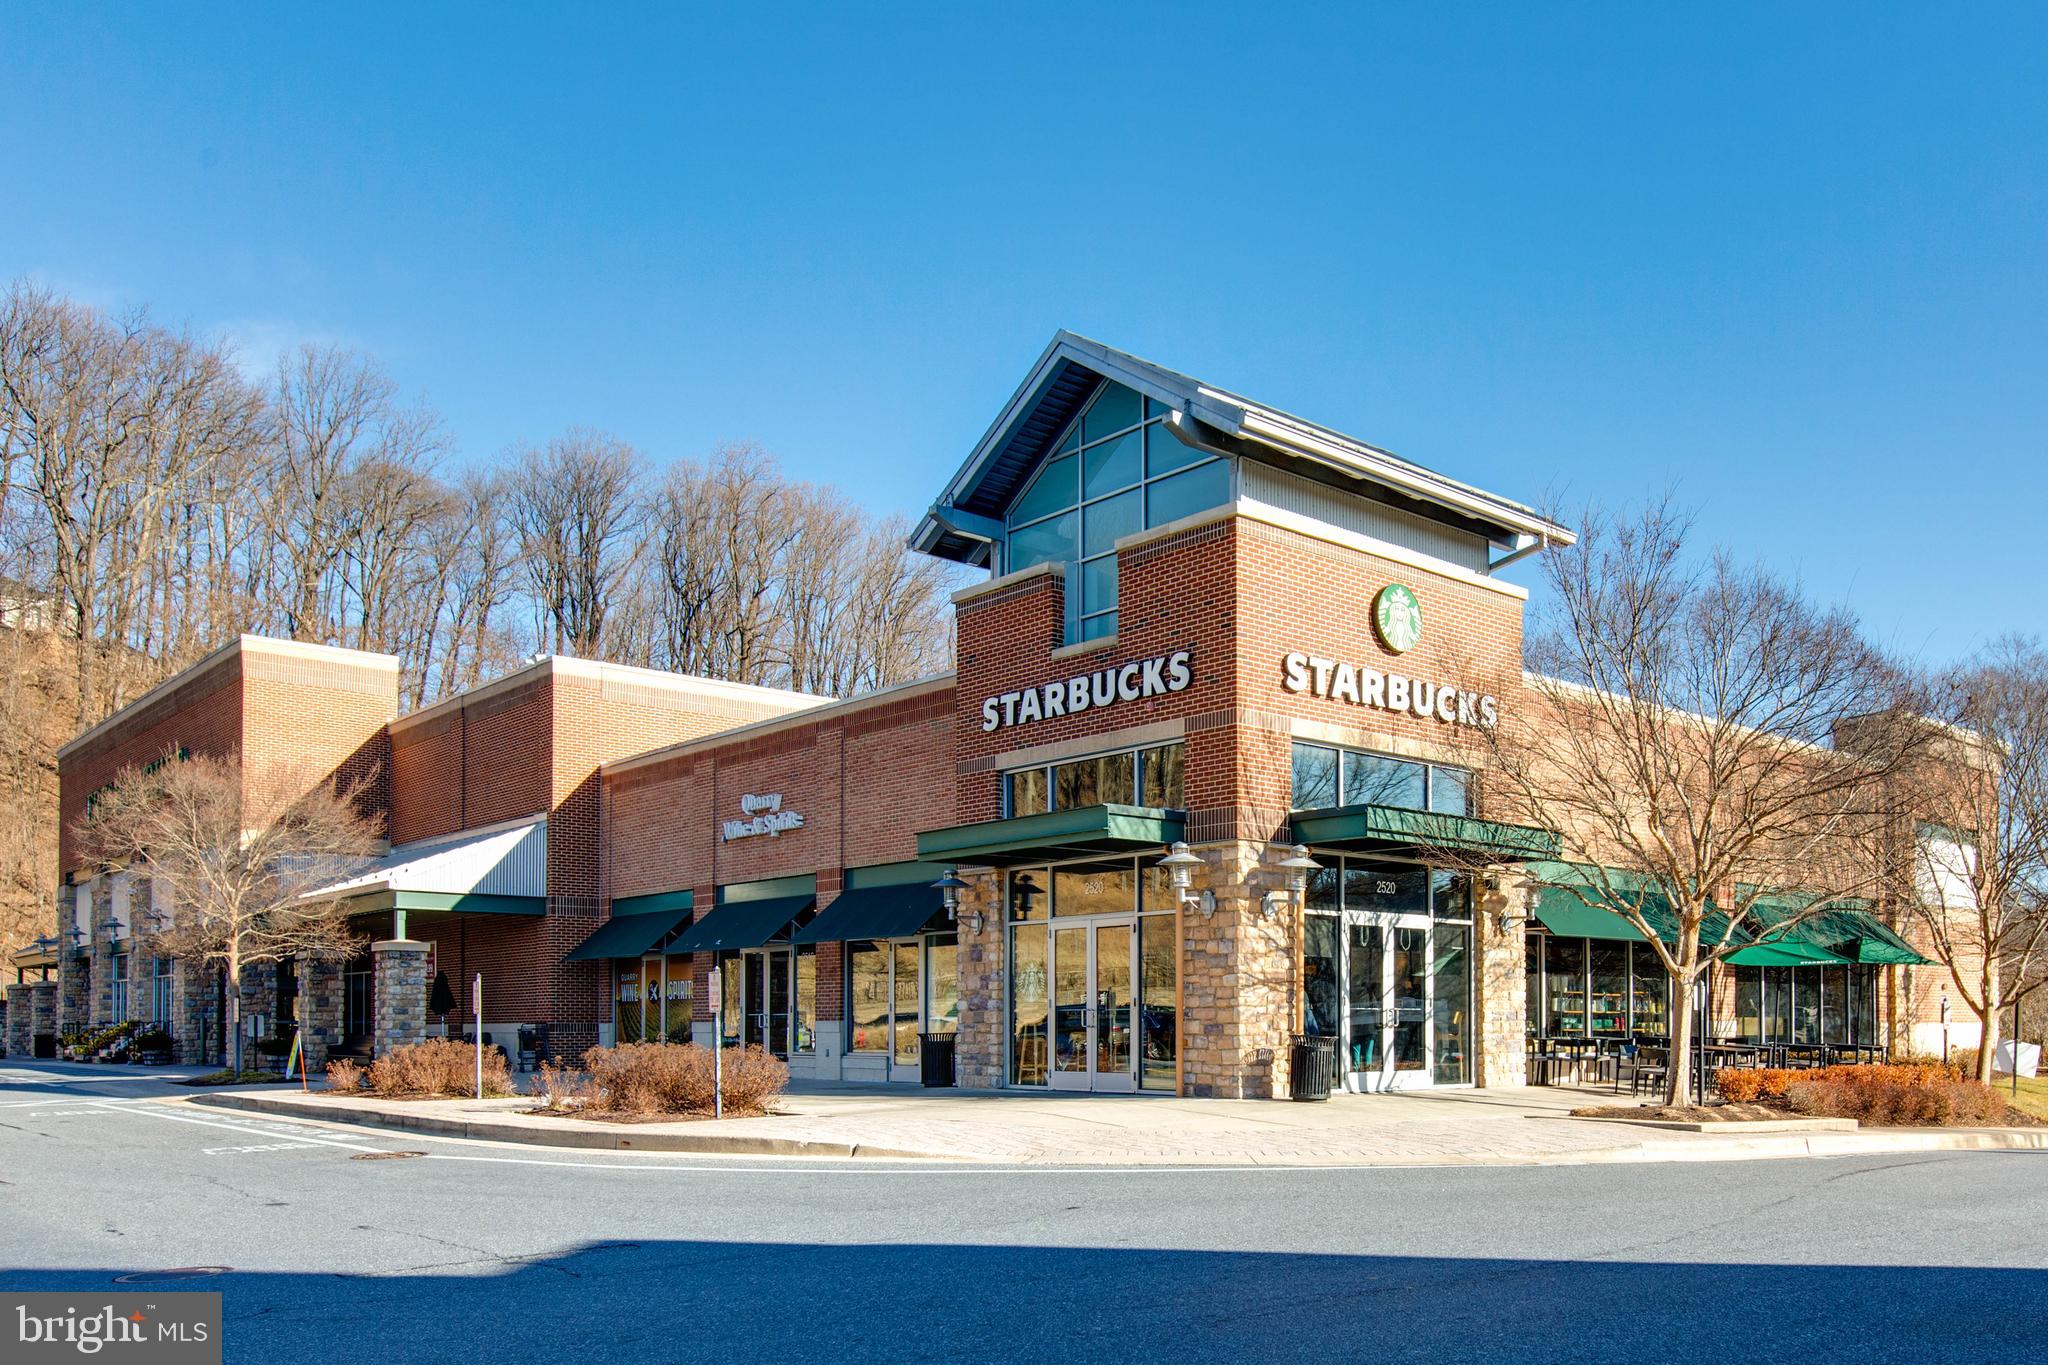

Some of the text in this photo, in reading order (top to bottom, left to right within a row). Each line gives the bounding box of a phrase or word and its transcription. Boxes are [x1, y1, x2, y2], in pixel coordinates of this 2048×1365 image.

[982, 652, 1191, 732] STARBUCKS
[1284, 652, 1499, 729] STARBUCKS
[741, 793, 783, 815] Quarry
[722, 811, 804, 841] Wine & Spirits
[1085, 881, 1104, 894] 2520
[1376, 880, 1396, 894] 2520
[621, 983, 639, 1002] WINE
